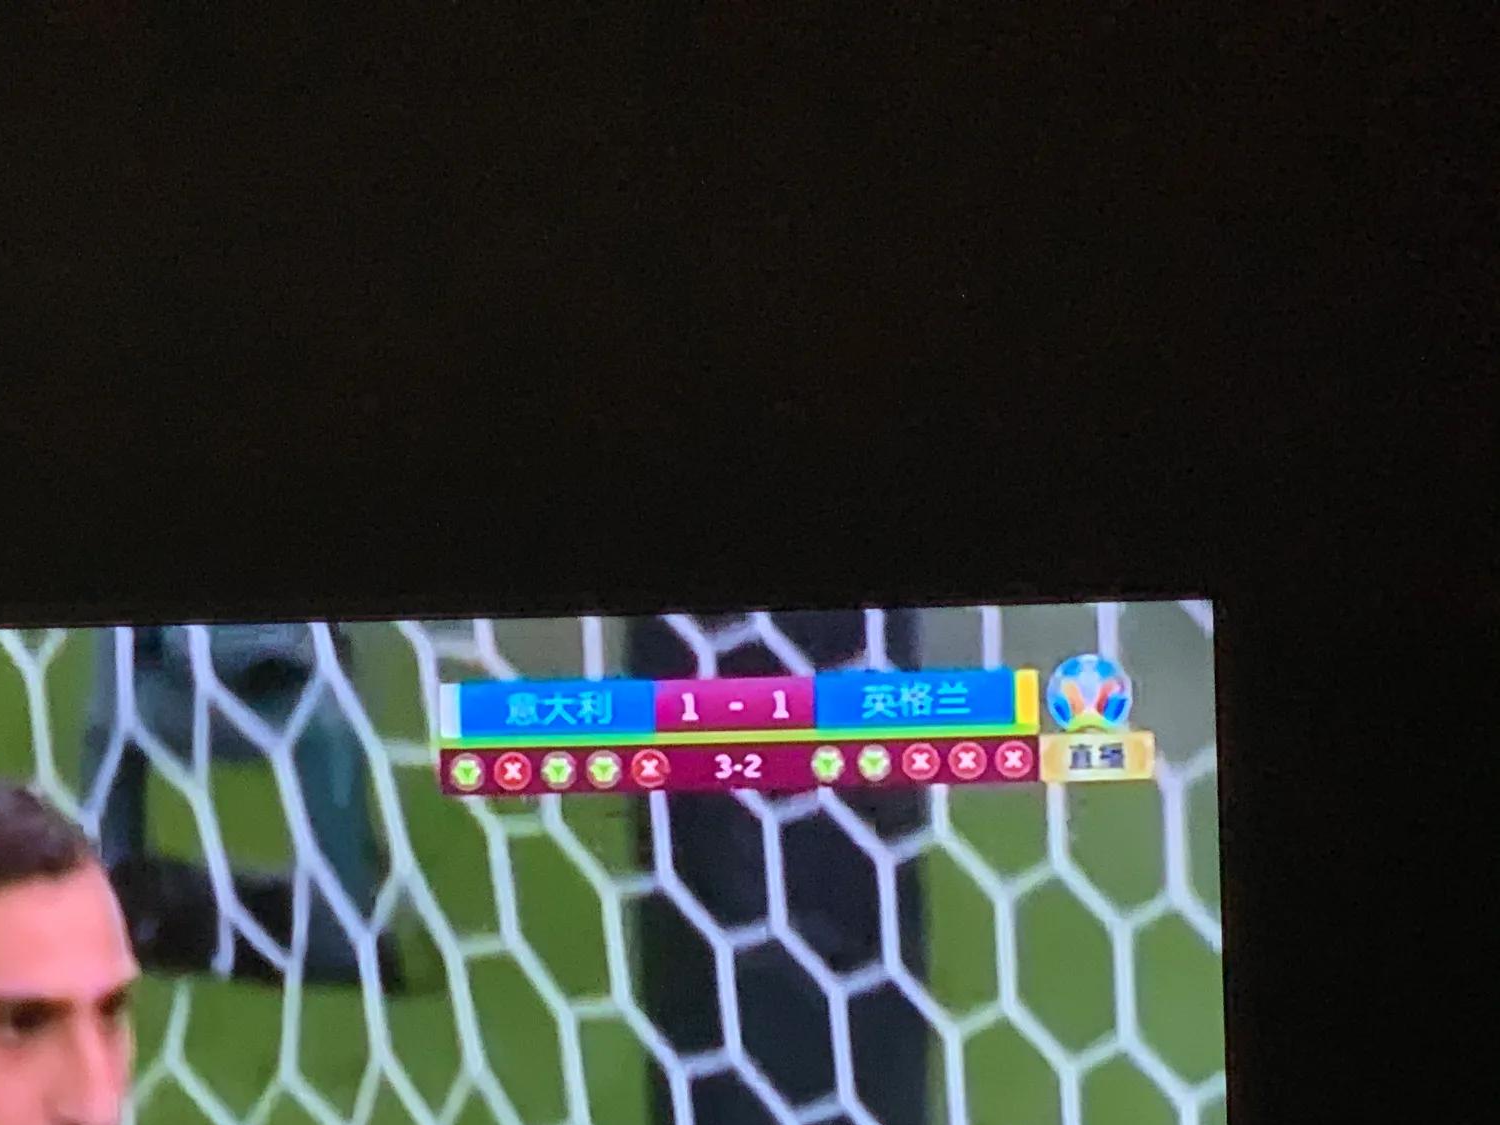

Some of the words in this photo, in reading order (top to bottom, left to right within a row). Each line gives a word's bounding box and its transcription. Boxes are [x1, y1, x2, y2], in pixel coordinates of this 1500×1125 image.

[506, 690, 612, 725] 意大利
[862, 682, 971, 718] 英格兰
